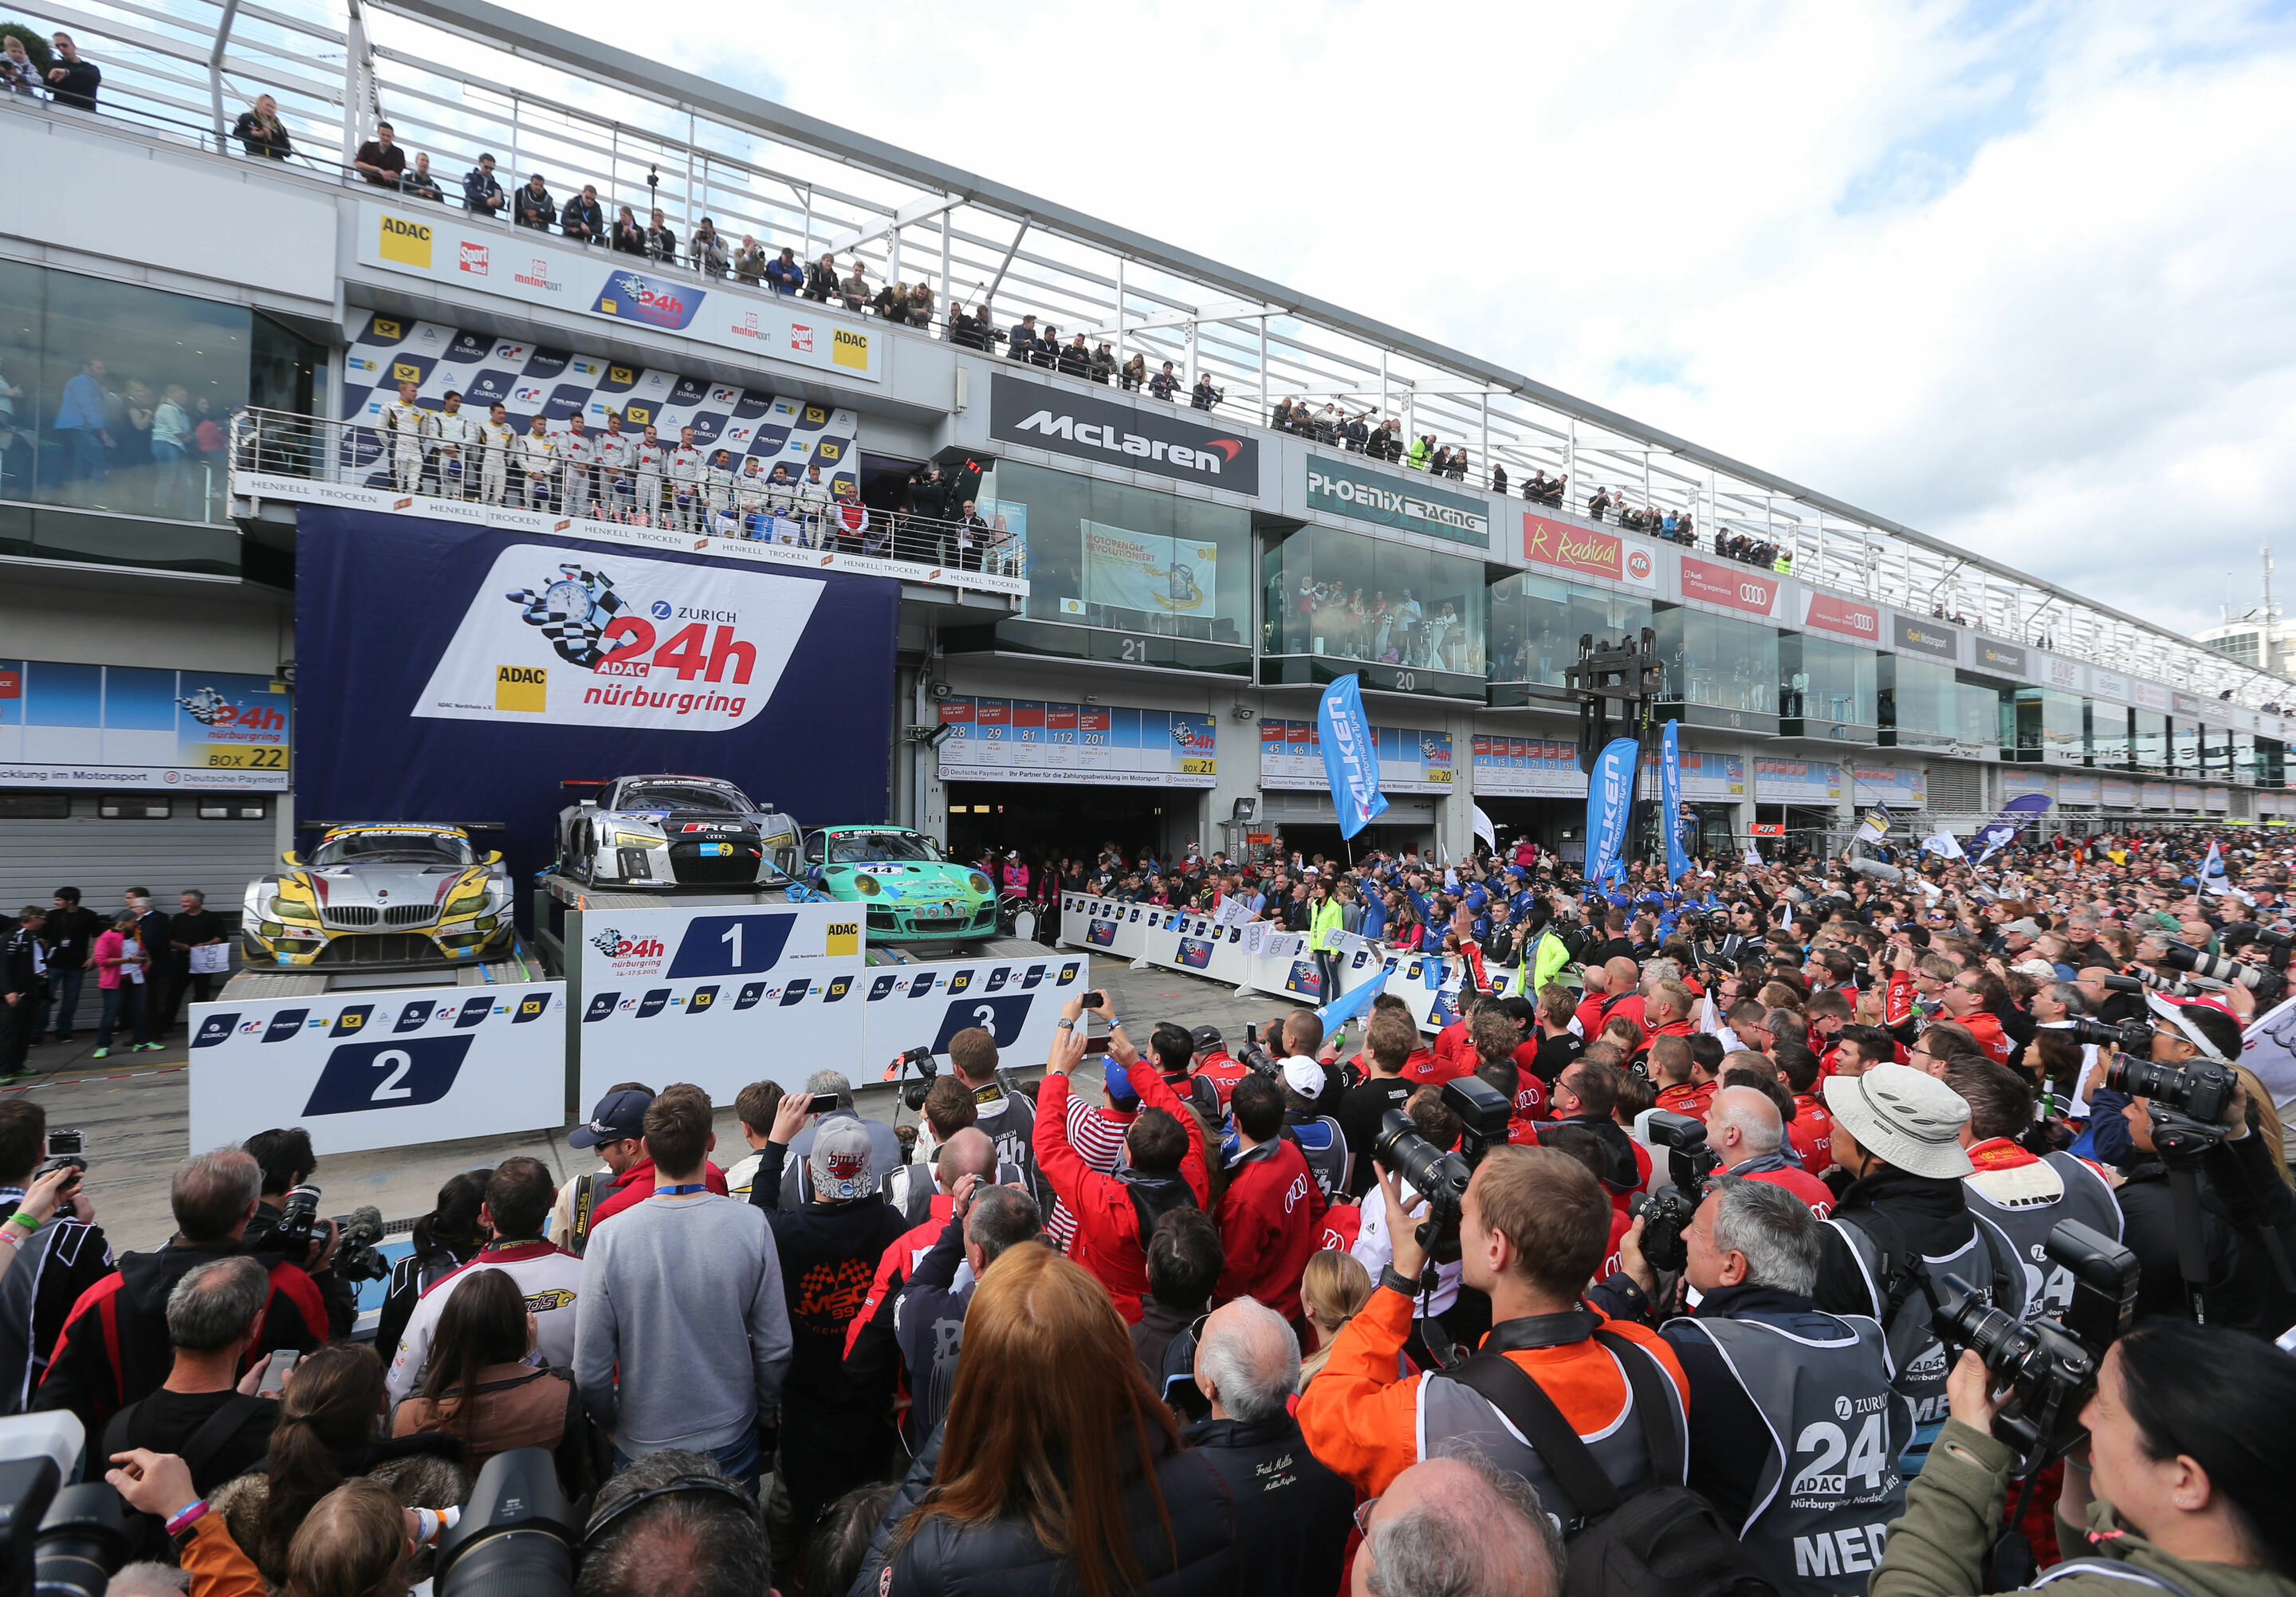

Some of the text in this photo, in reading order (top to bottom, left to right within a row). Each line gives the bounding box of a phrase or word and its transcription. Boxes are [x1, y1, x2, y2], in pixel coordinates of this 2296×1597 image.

[383, 218, 431, 242] ADAC
[460, 246, 489, 264] Sport
[470, 264, 486, 274] Bild
[640, 290, 683, 315] 24h
[792, 328, 813, 342] Sport
[835, 331, 867, 348] ADAC
[454, 345, 484, 356] ZURICH
[799, 341, 812, 351] Bild
[473, 388, 503, 399] ZURICH
[677, 391, 702, 400] ZURICH
[552, 397, 582, 407] FALKEN
[743, 397, 769, 407] FALKEN
[693, 428, 718, 439] ZURICH
[758, 435, 784, 445] FALKEN
[1015, 409, 1221, 474] McLaren
[250, 479, 377, 504] HENKELL TROCKEN
[430, 503, 541, 526] HENKELL TROCKEN
[584, 525, 682, 545] HENKELL TROCKEN
[1085, 533, 1145, 553] MOTORENÖLE
[1530, 522, 1618, 566] R Radical
[721, 544, 809, 561] HENKELL TROCKEN
[1085, 542, 1156, 563] REVOLUTIONIERT
[843, 560, 920, 576] HENKELL TROCKEN
[1630, 557, 1648, 571] RTR
[950, 573, 1020, 590] HENKELL TROCKEN
[1690, 571, 1703, 580] Audi
[1690, 578, 1732, 596] driving experience
[678, 606, 737, 623] ZURICH
[1907, 628, 1947, 649] Opel Motorsport
[603, 616, 757, 685] 24h
[1122, 638, 1146, 663] 21
[1985, 648, 1997, 661] Opel
[498, 667, 545, 685] ADAC
[596, 660, 647, 678] ADAC
[2051, 661, 2075, 679] ROWE
[1396, 671, 1415, 691] 20
[583, 684, 746, 718] nürburgring
[213, 706, 286, 730] 24h
[1729, 712, 1740, 727] 18
[207, 730, 281, 743] nürburgring
[949, 725, 966, 738] 28
[986, 727, 1002, 740] 29
[1021, 729, 1036, 742] 81
[1052, 731, 1074, 743] 112
[1084, 733, 1105, 745] 201
[1185, 734, 1215, 749] 24h
[1268, 743, 1280, 753] 45
[1349, 710, 1372, 786] Performance Tyres
[209, 748, 282, 767] BOX 22
[1293, 745, 1304, 755] 46
[1431, 749, 1451, 761] 24h
[1200, 760, 1213, 773] 21
[1327, 696, 1373, 823] FALKEN
[1562, 761, 1573, 770] 153
[51, 770, 148, 781] im Motorsport
[183, 773, 285, 785] Deutsche Payment
[1063, 773, 1121, 781] Zahlungsabwicklung
[1441, 771, 1452, 781] 20
[619, 813, 651, 822] 28
[696, 823, 743, 832] R8
[1610, 800, 1624, 859] Performance
[1757, 824, 1777, 834] RTR
[828, 923, 859, 936] ADAC
[615, 939, 664, 958] 24h
[721, 922, 743, 968] 1
[1190, 946, 1207, 960] 24h
[611, 958, 662, 969] nürburgring
[973, 1005, 997, 1037] 3
[200, 1031, 228, 1040] ZURICH
[370, 1048, 412, 1102] 2
[1215, 1077, 1242, 1087] TOT
[995, 1129, 1017, 1143] ZURICH
[996, 1136, 1026, 1165] 4h
[828, 1154, 865, 1168] BULLS
[576, 1191, 589, 1235] Nikon D4s
[832, 1305, 855, 1320] 99
[1256, 1461, 1273, 1477] Fred
[1790, 1474, 1901, 1511] Nürburgring 2015
[1795, 1477, 1842, 1493] ADAC
[1793, 1522, 1888, 1577] MED
